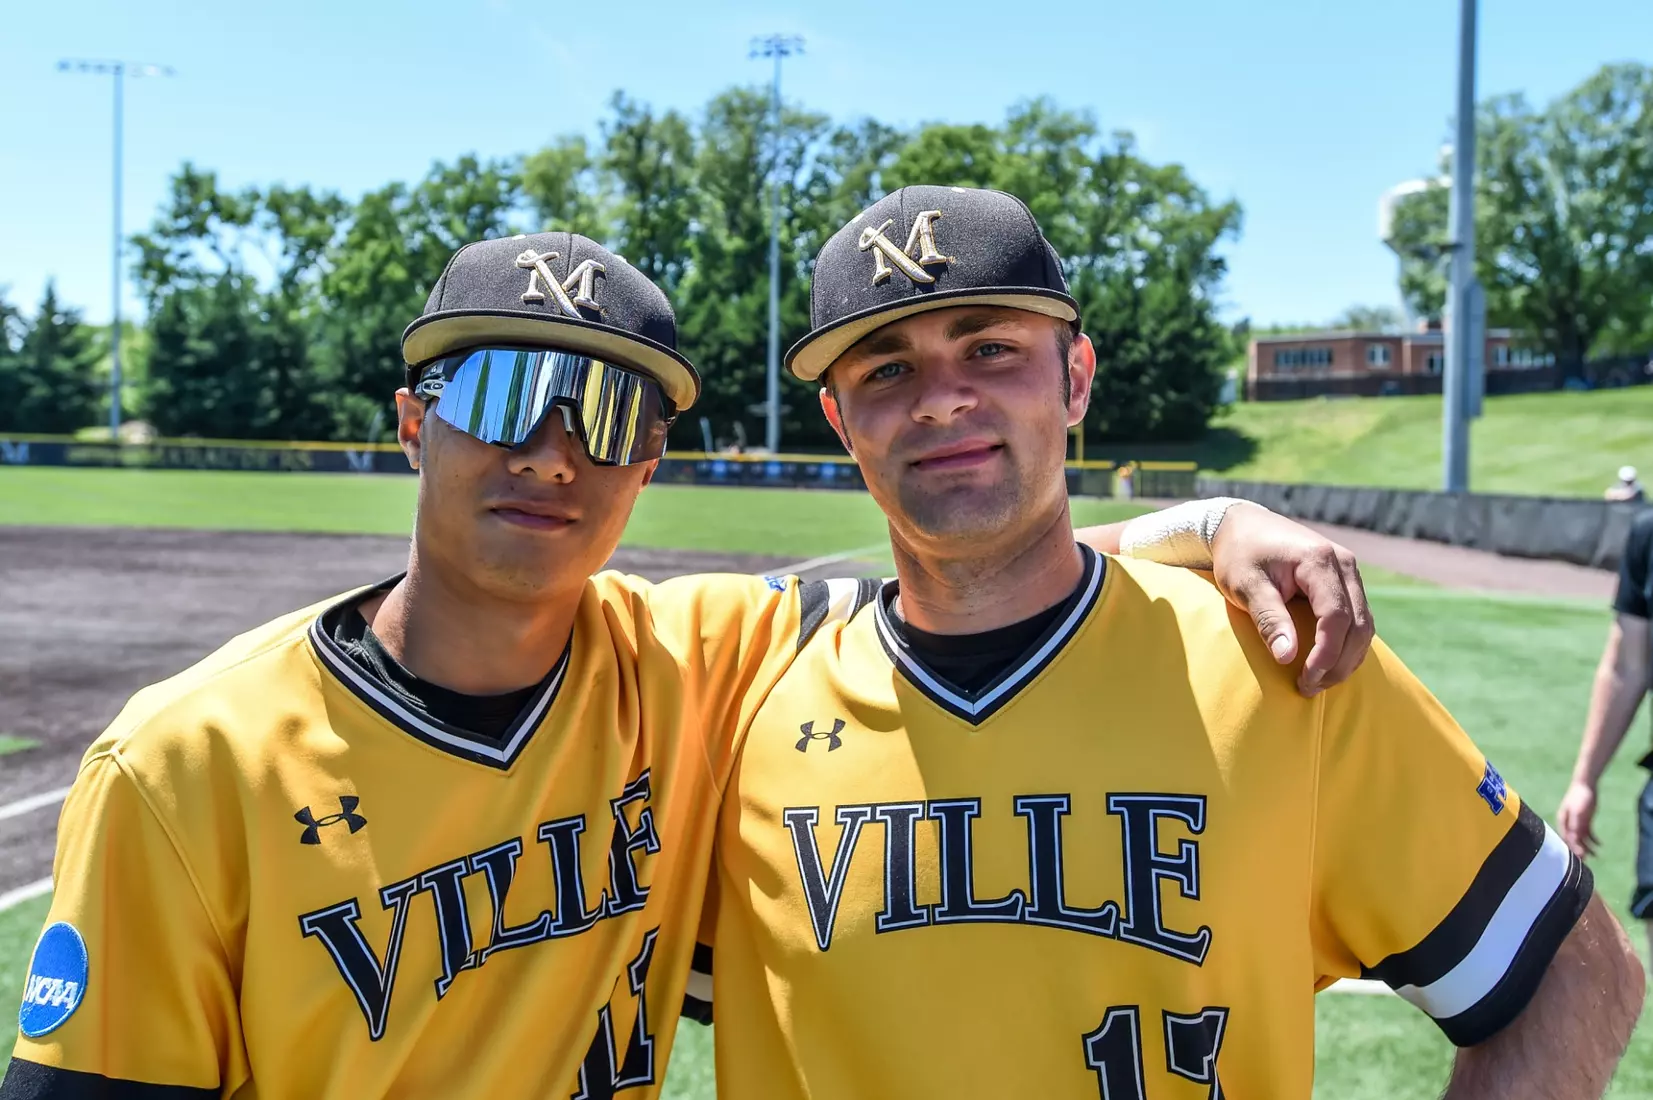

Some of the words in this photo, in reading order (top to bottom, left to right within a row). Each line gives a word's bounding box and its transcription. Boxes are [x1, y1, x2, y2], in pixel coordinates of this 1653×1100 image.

[298, 767, 661, 1041] VILLE
[783, 792, 1213, 967] VILLE
[25, 974, 79, 1010] NCAA
